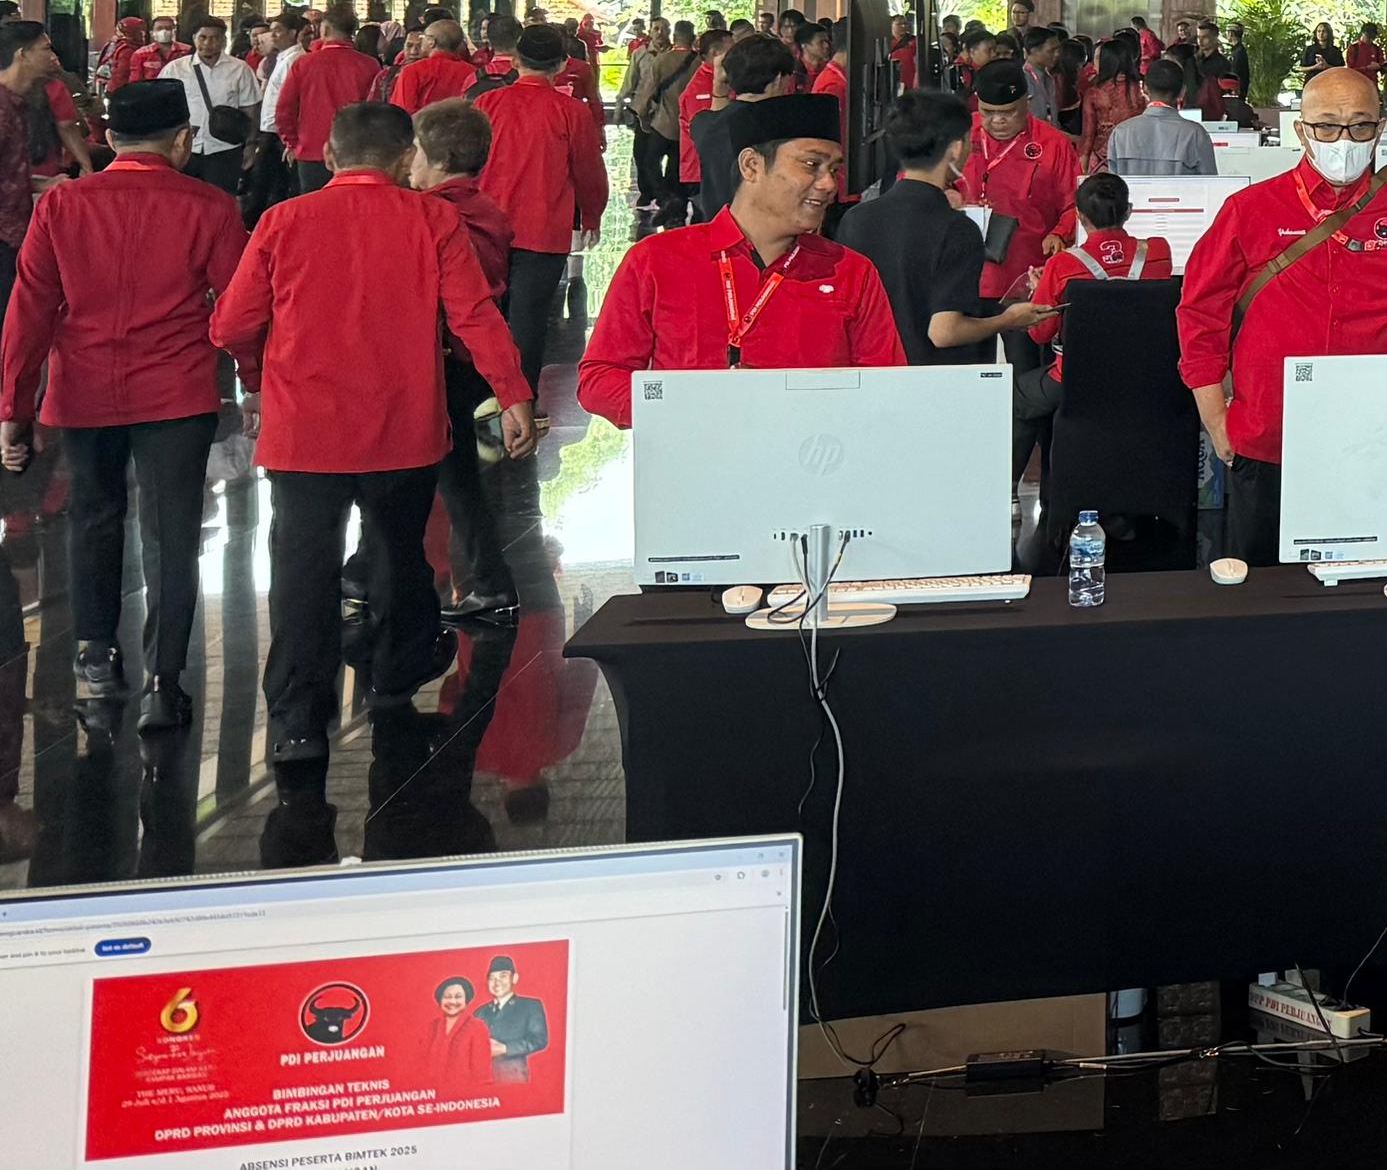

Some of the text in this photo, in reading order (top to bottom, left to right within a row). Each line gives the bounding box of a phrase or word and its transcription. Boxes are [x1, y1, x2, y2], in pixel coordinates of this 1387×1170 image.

[803, 432, 842, 478] hp
[280, 1046, 385, 1066] PDI PERJUANGAN
[273, 1079, 390, 1100] BIMBINGAN TEKNIS
[223, 1089, 436, 1119] ANGGOTA FRAKSI PDI PERJUANGAN
[154, 1097, 501, 1141] DPRD PROVINSI & DPRD KABUPATEN/KOTA SE-INDONESIA
[239, 1158, 290, 1170] ABSENSI
[291, 1153, 343, 1167] PESERTA
[344, 1148, 388, 1162] BIMTEK
[390, 1145, 418, 1157] 2025
